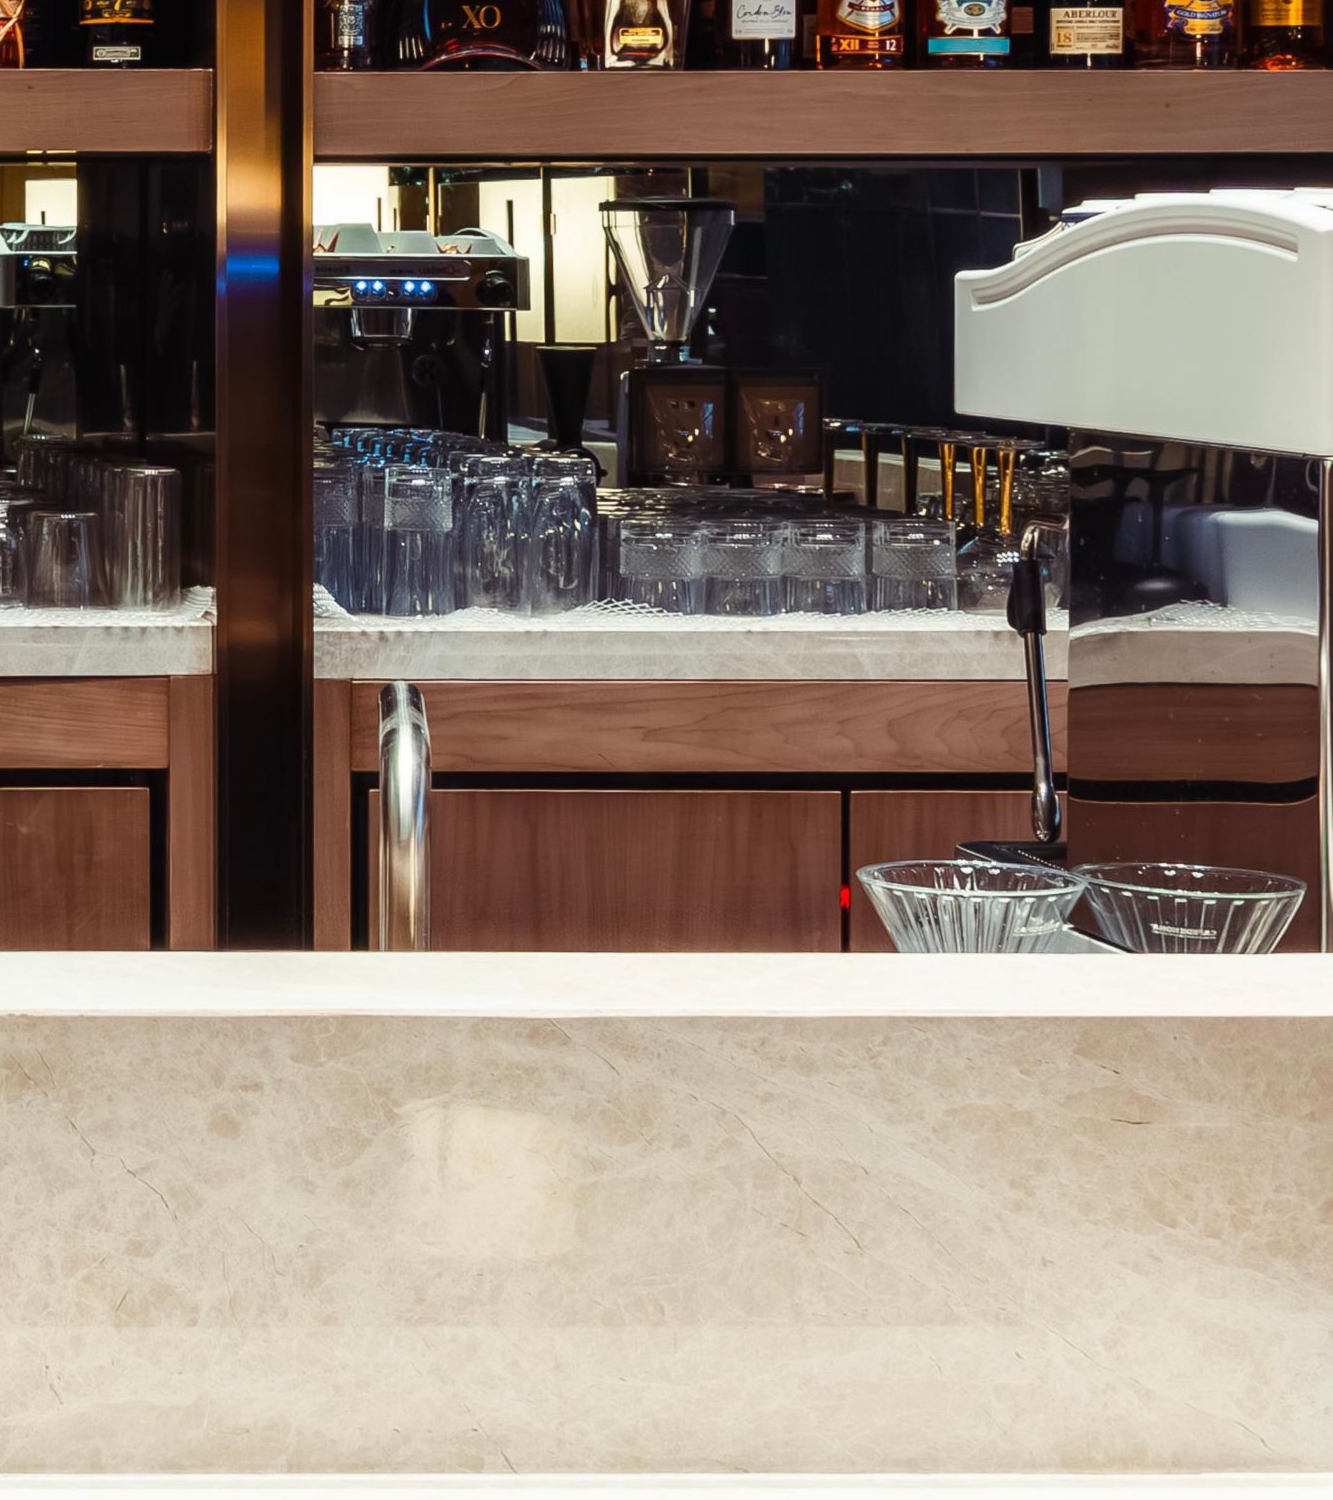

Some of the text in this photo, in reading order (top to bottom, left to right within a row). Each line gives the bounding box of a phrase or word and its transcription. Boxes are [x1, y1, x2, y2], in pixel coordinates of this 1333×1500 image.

[461, 4, 501, 29] XO
[1063, 10, 1117, 18] ABERLOUR
[1057, 32, 1072, 44] 18
[839, 39, 859, 50] XII
[885, 40, 897, 51] 12
